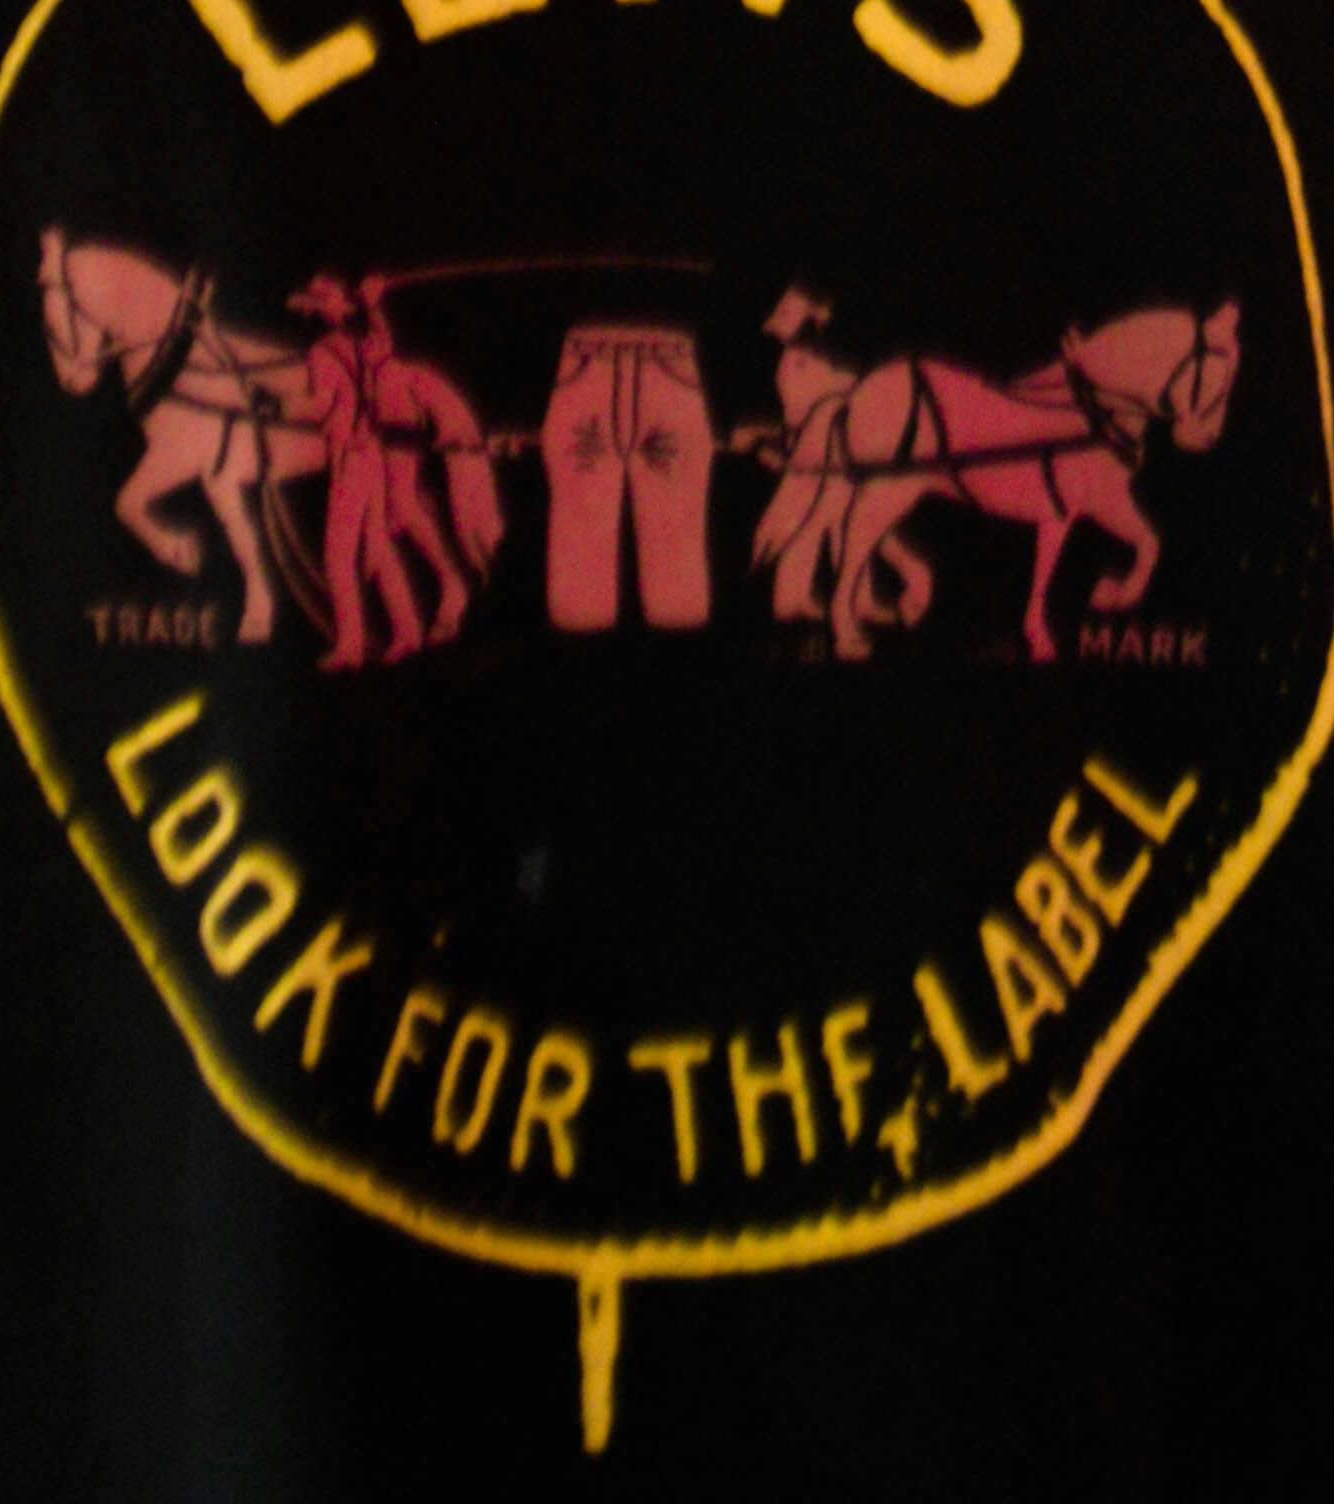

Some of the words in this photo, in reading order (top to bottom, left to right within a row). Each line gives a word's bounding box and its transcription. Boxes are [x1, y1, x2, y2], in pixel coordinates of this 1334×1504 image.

[1077, 624, 1207, 665] MARK
[105, 695, 371, 1068] LOOK
[375, 991, 592, 1178] FOR
[913, 758, 1198, 1096] LABEL
